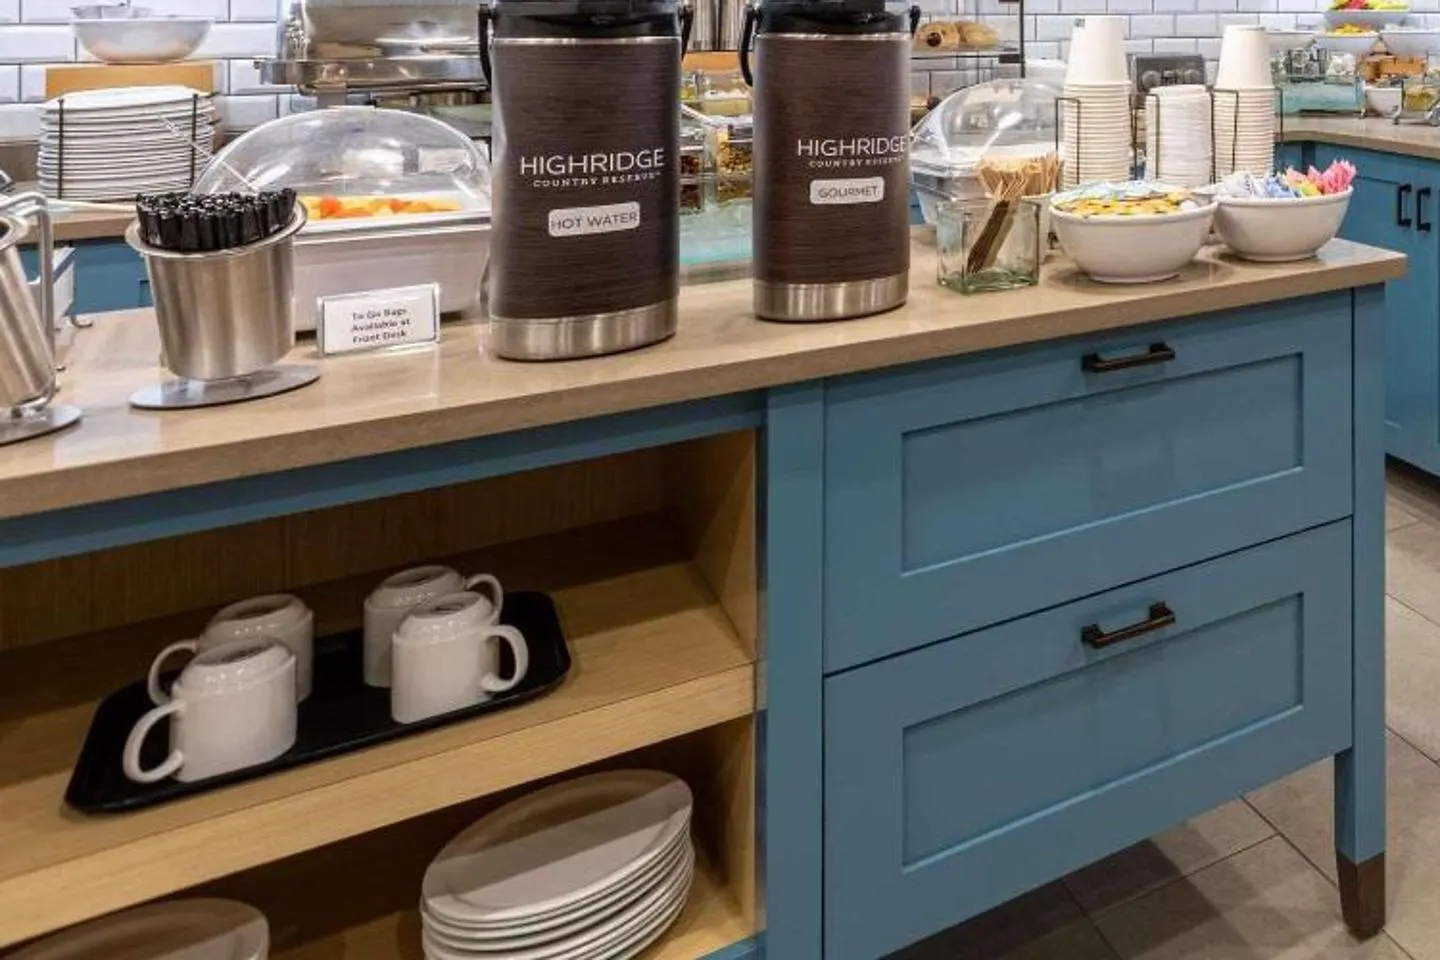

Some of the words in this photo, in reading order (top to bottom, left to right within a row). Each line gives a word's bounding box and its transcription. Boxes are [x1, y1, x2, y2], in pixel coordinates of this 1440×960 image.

[797, 136, 906, 156] HIGHRIDGE
[520, 148, 665, 176] HIGHRIDGE
[533, 178, 598, 188] COUNTRY
[819, 186, 878, 198] GOURMET
[551, 218, 581, 230] HOT
[587, 211, 638, 228] WATER
[367, 310, 380, 319] Go
[383, 308, 407, 317] Bags
[352, 321, 397, 332] Available
[353, 334, 379, 344] Front
[383, 330, 406, 340] Desk
